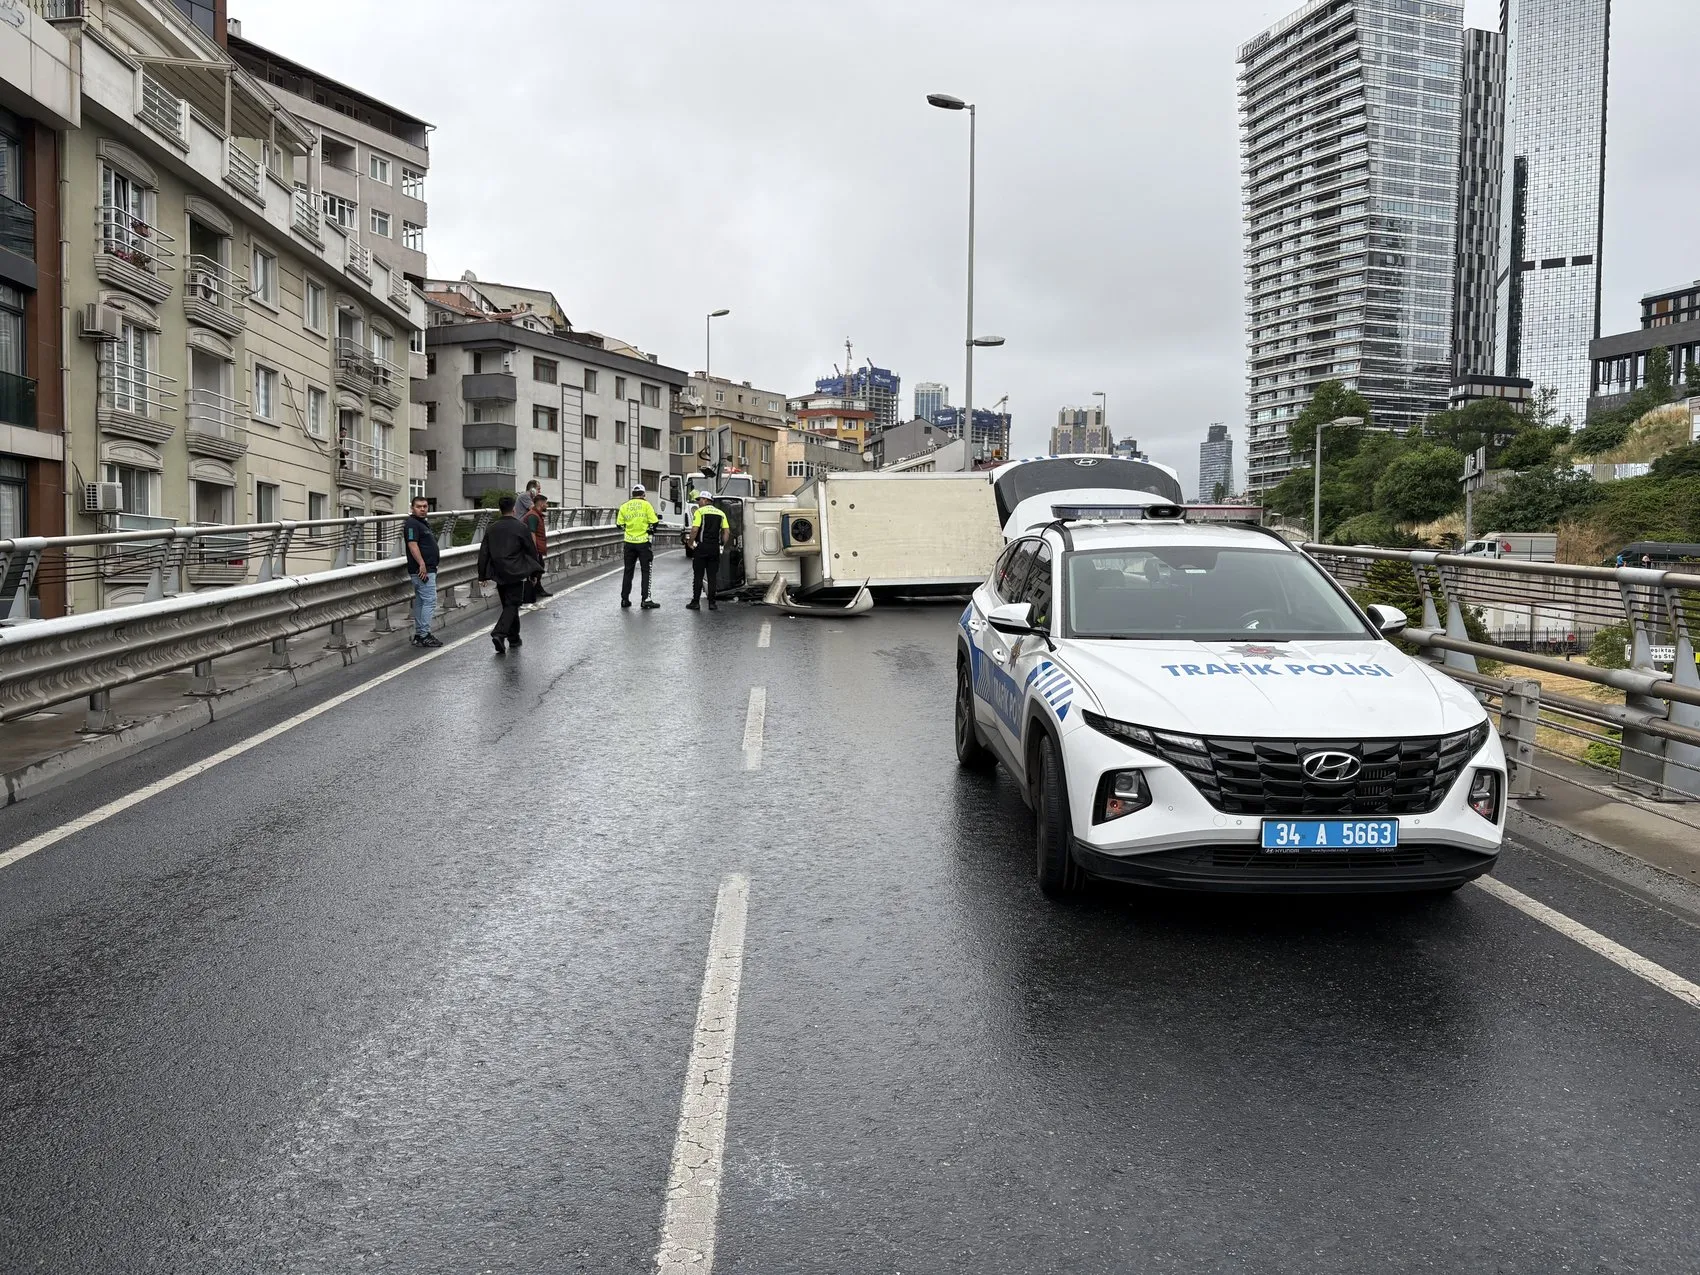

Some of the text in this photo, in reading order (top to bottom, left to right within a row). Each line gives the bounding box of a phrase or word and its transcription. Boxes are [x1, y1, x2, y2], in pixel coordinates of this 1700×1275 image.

[1161, 662, 1394, 677] TRAFİK POLİSİ
[1276, 823, 1391, 845] 34 A 5663
